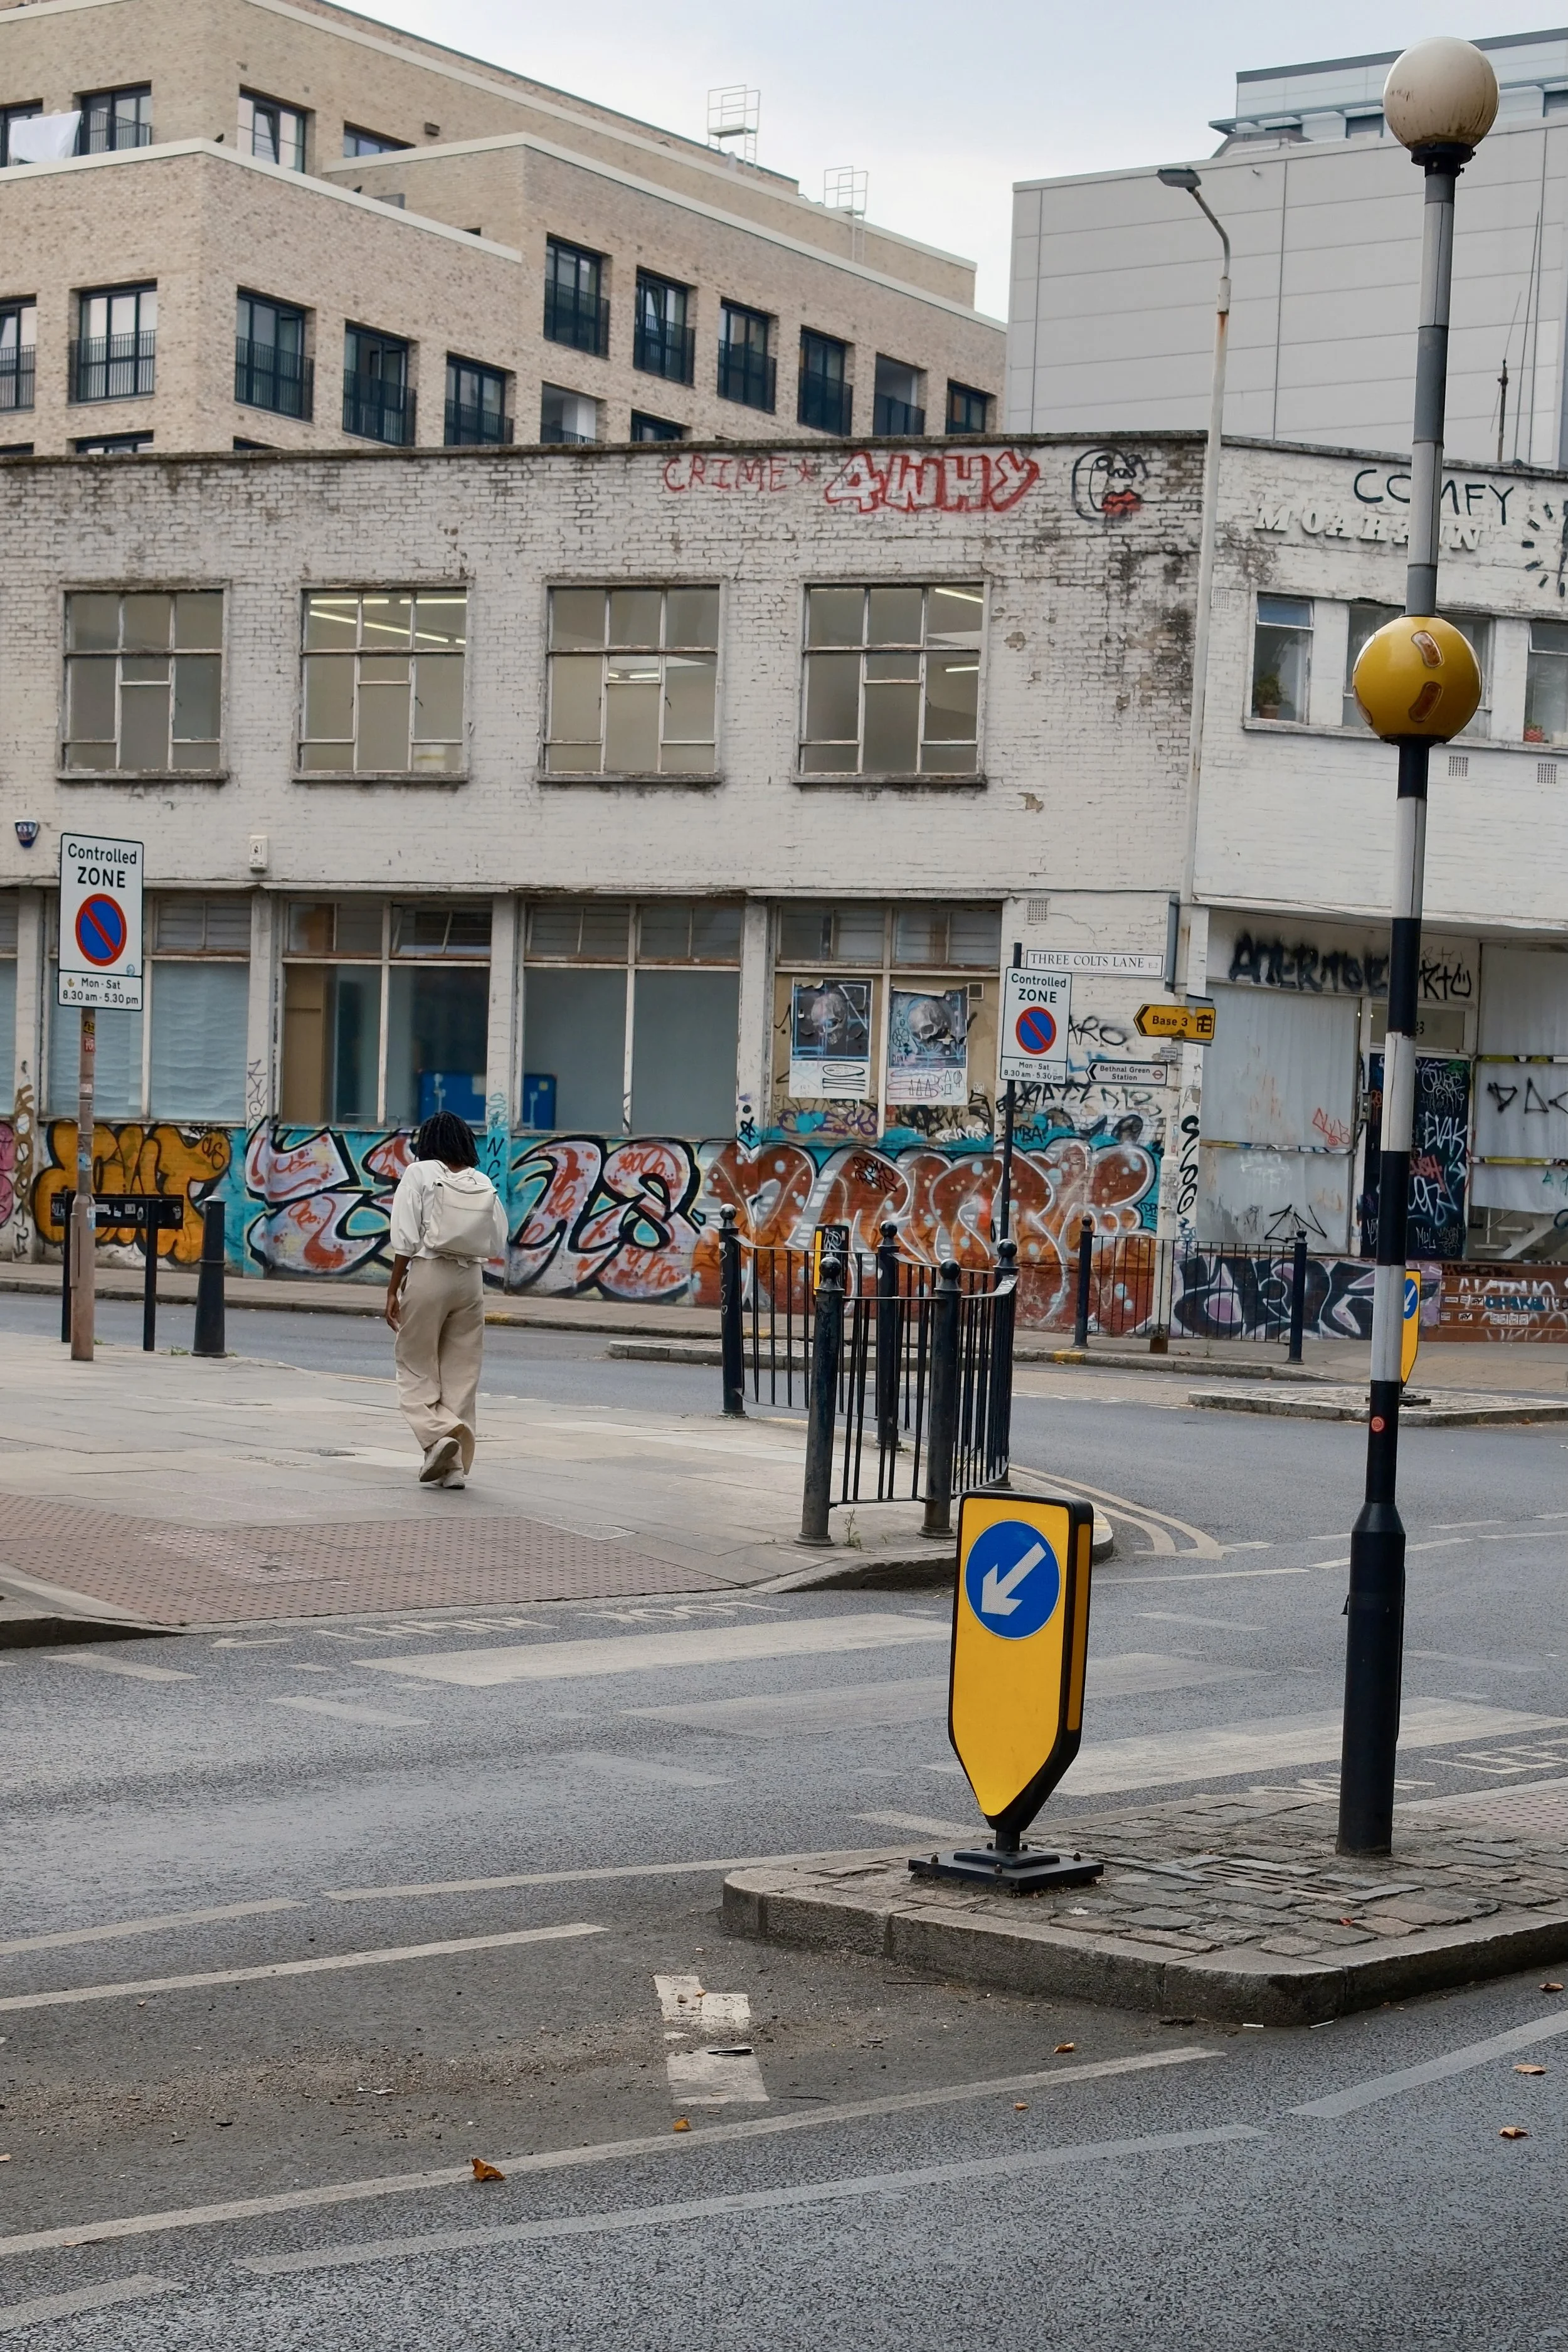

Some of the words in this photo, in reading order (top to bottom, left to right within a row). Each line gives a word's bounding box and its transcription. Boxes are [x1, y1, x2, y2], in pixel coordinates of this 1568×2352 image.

[664, 454, 787, 492] CRIME
[68, 843, 137, 864] Controlled
[78, 866, 125, 888] ZONE
[1030, 953, 1069, 965] THREE
[1074, 955, 1108, 967] COLTS
[1113, 956, 1144, 968] LANE
[82, 977, 99, 988] Mon
[106, 979, 120, 990] Sat
[1011, 973, 1066, 988] Controlled
[63, 990, 83, 1000] 8.30
[85, 993, 98, 1002] am
[104, 992, 124, 1004] 5.30
[126, 995, 139, 1006] pm
[1018, 988, 1057, 1004] ZONE
[1152, 1015, 1177, 1026] Base
[1181, 1018, 1188, 1027] 3
[578, 1600, 791, 1624] LOOK
[313, 1616, 561, 1644] RIGHT
